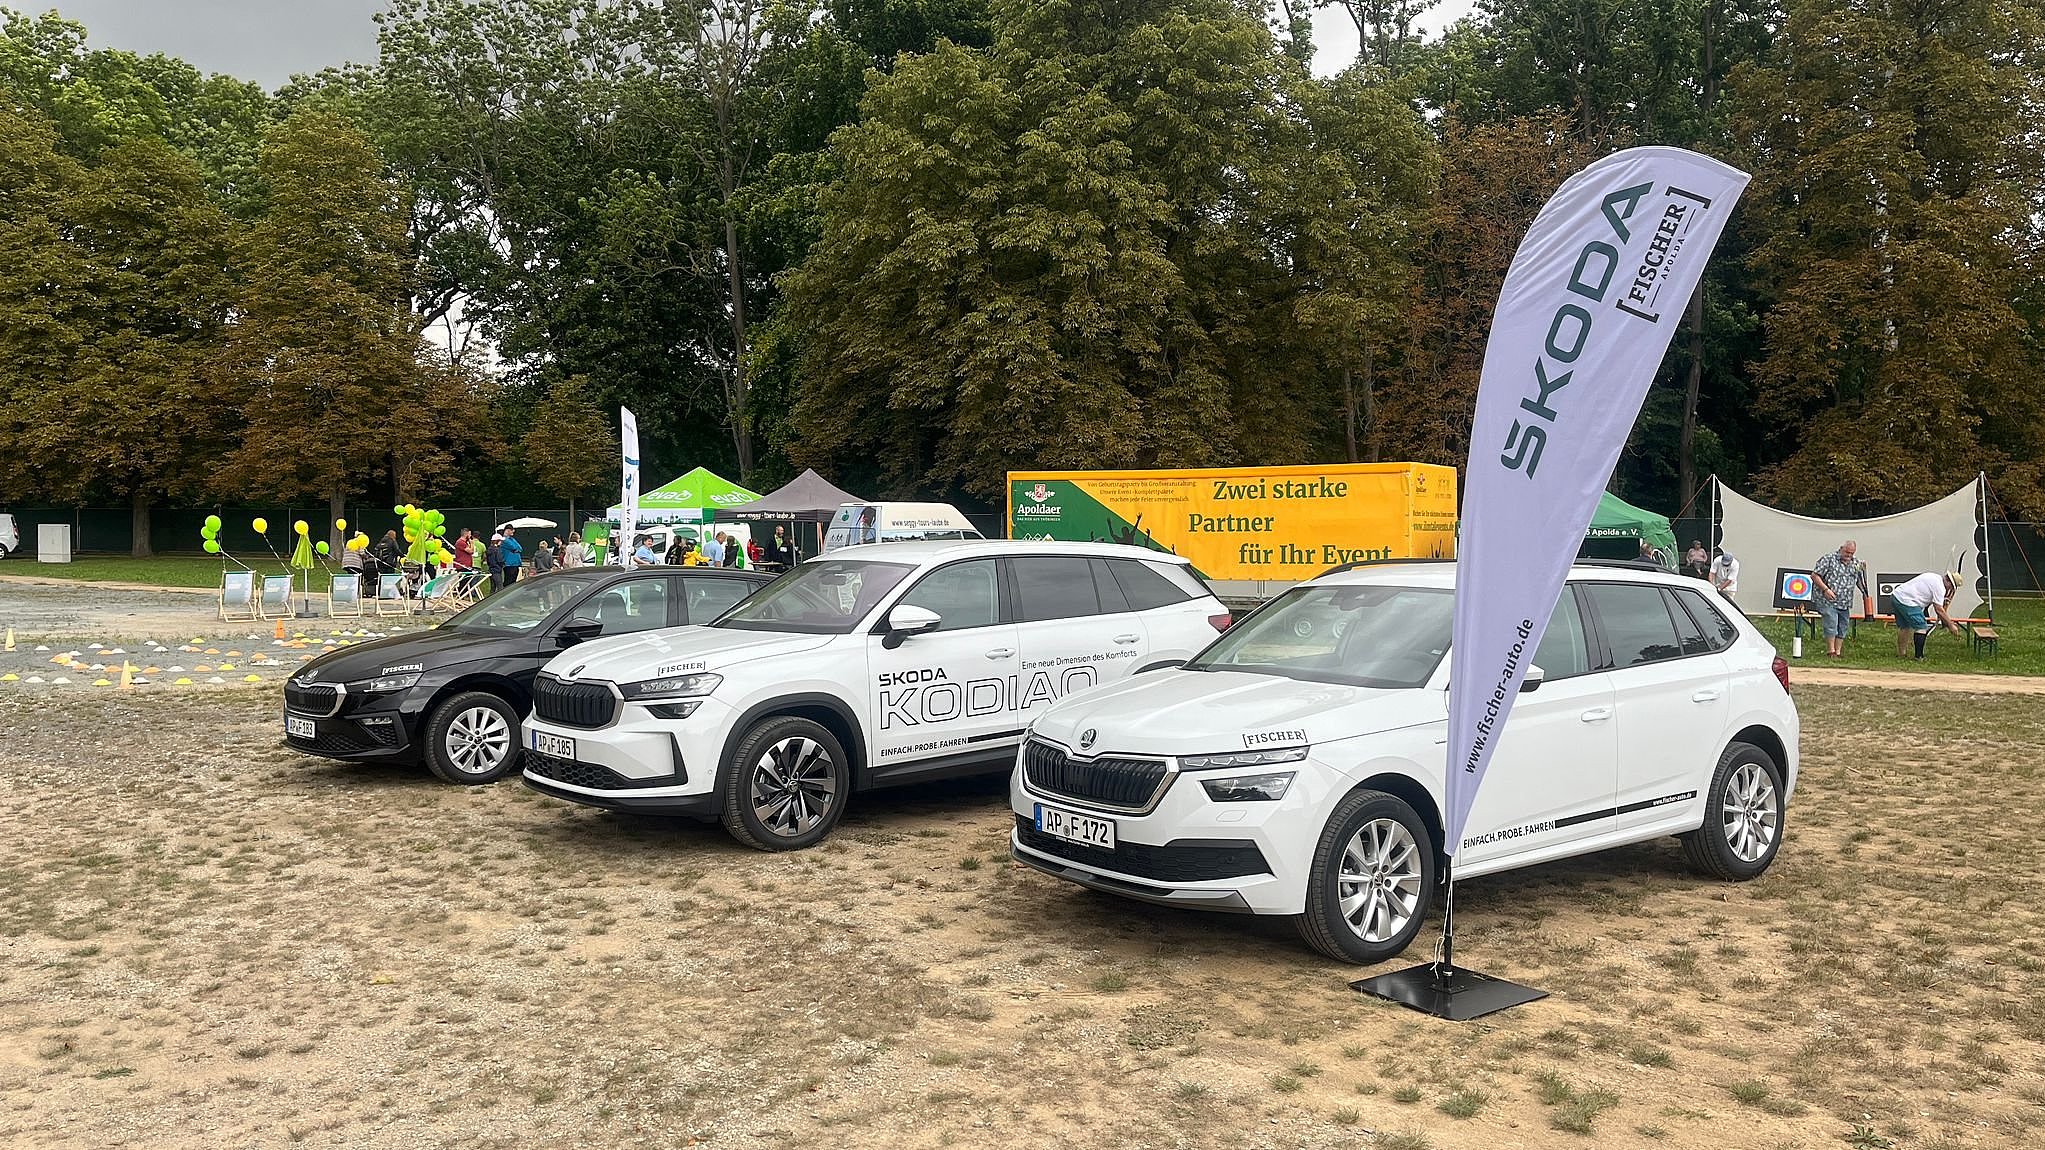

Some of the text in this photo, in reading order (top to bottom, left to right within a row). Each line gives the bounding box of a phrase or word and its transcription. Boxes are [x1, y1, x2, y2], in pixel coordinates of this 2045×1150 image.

[1661, 237, 1686, 280] APOLDA
[1213, 476, 1348, 500] Zwei starke
[1017, 504, 1061, 516] Apoldaer
[1188, 513, 1275, 533] Partner
[1592, 528, 1620, 537] Apolda
[1239, 543, 1392, 565] für Ihr Event
[1022, 650, 1137, 670] Eine neue Dimension des Komforts
[1464, 618, 1534, 775] www.fischer-auto.de
[557, 739, 570, 756] 185
[880, 737, 967, 757] EINFACH.PROBE.FAHREN
[1046, 811, 1062, 832] AP
[1071, 816, 1079, 836] F
[1082, 820, 1108, 844] 172
[1463, 820, 1554, 849] EINFACH.PROBE.FAHREN
